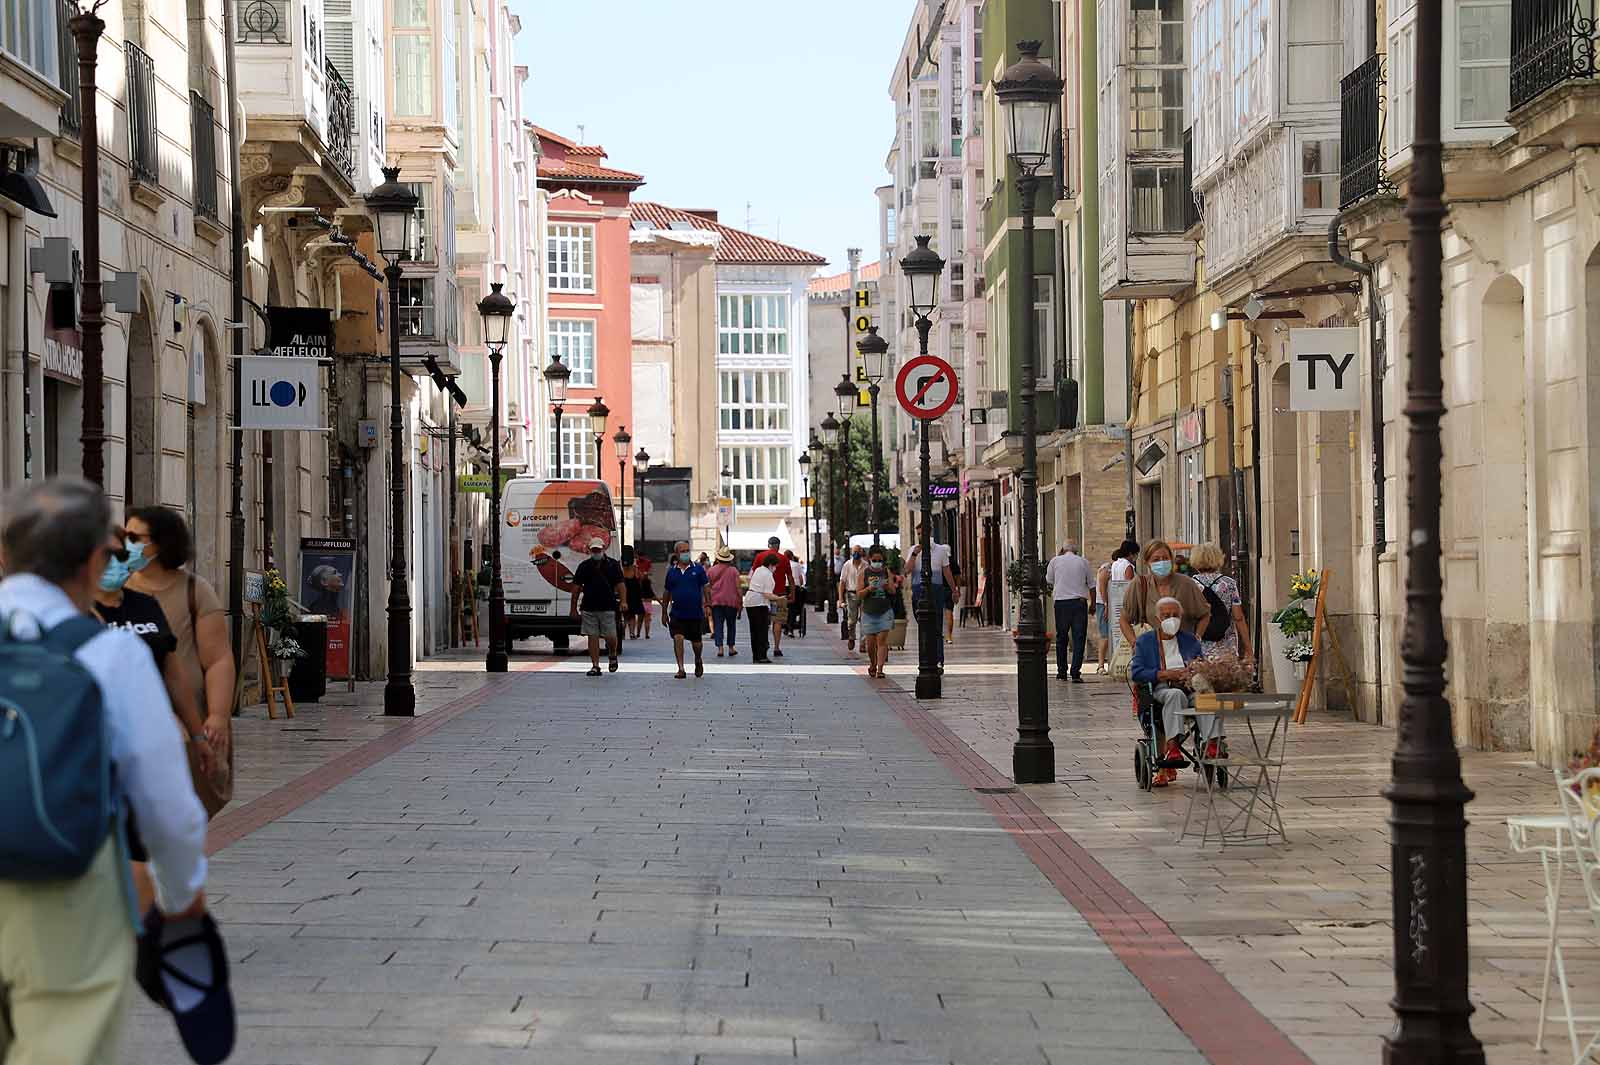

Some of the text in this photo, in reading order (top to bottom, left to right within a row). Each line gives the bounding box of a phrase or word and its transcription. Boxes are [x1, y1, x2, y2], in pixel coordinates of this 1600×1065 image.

[290, 334, 327, 346] ALAIN
[273, 346, 327, 357] AFFLELOU
[1297, 353, 1355, 390] TY
[928, 484, 957, 495] Etam
